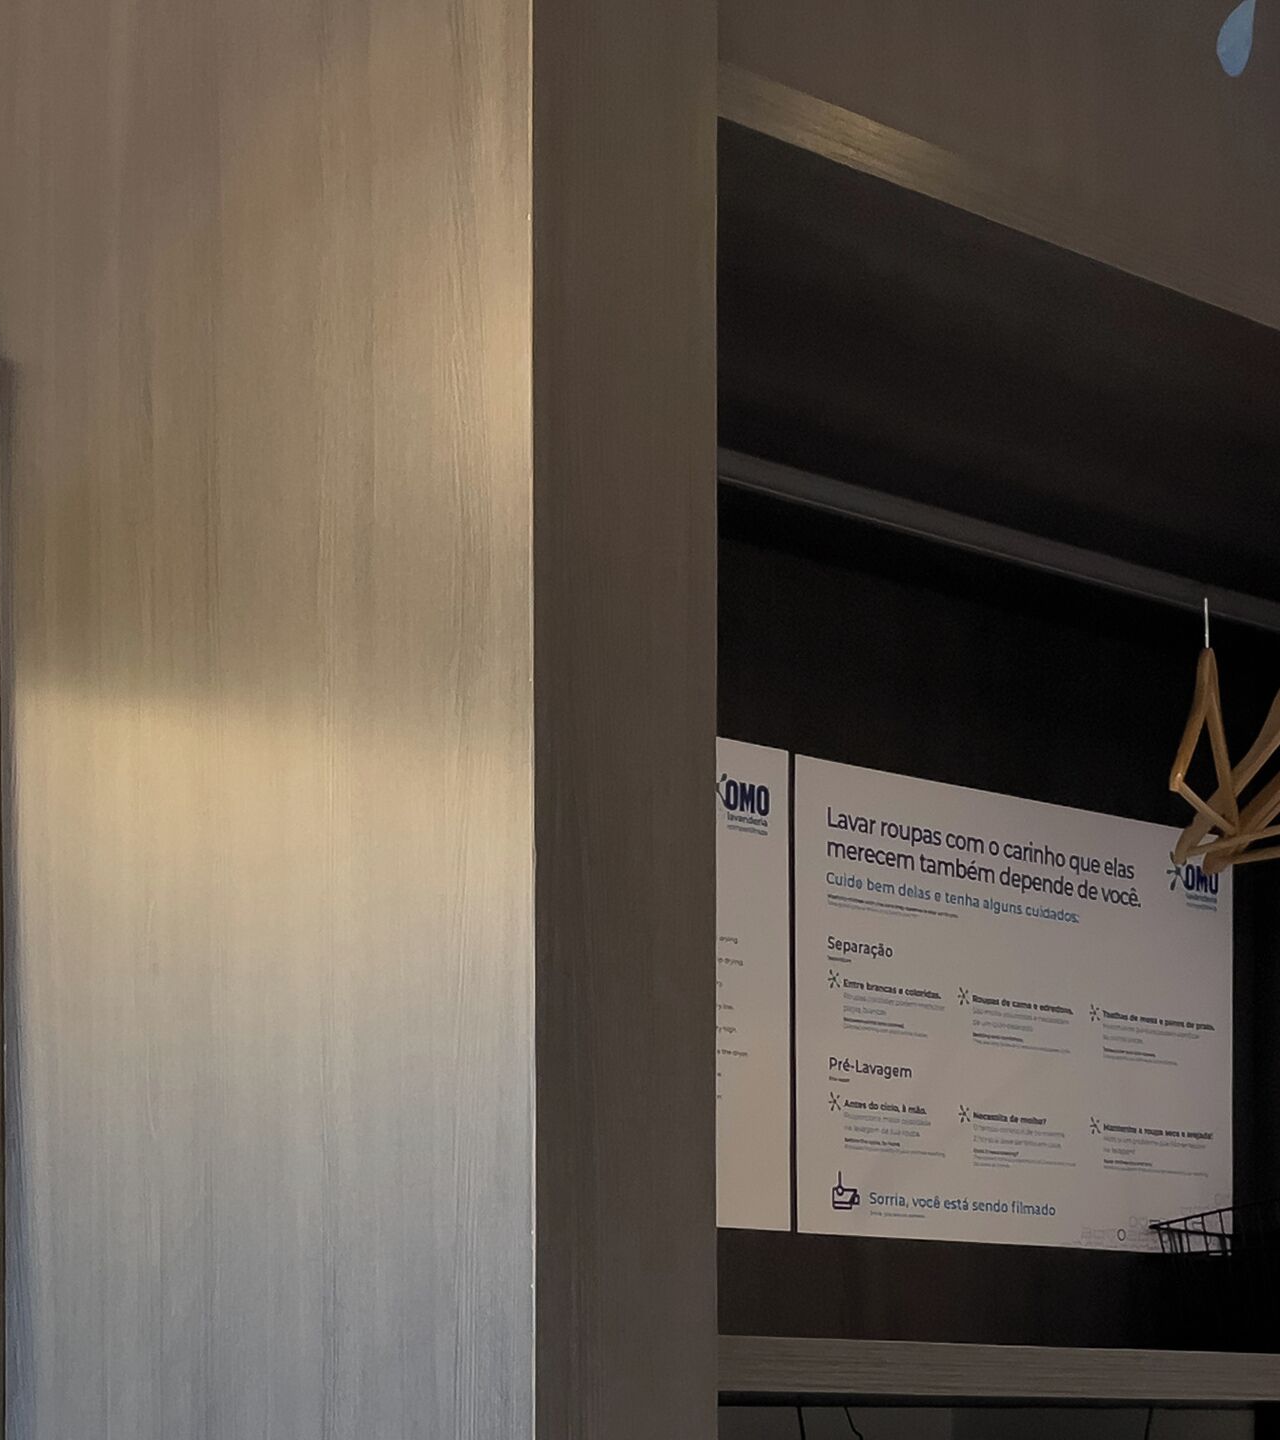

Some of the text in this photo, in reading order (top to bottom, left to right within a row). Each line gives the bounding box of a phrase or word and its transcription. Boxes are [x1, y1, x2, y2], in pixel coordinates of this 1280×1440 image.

[723, 779, 770, 817] OMO
[827, 806, 1135, 880] Lavar roupas com o carinho que elas
[827, 840, 1142, 908] merecem também depende de você.
[866, 877, 895, 896] bem
[898, 881, 931, 901] delas
[934, 890, 941, 902] e
[944, 891, 980, 909] tenha
[983, 897, 1022, 915] alguns
[827, 935, 893, 959] Separação
[828, 1056, 912, 1080] Pré-Lavagem
[868, 1191, 1056, 1217] Sorria, você está sendo filmado
